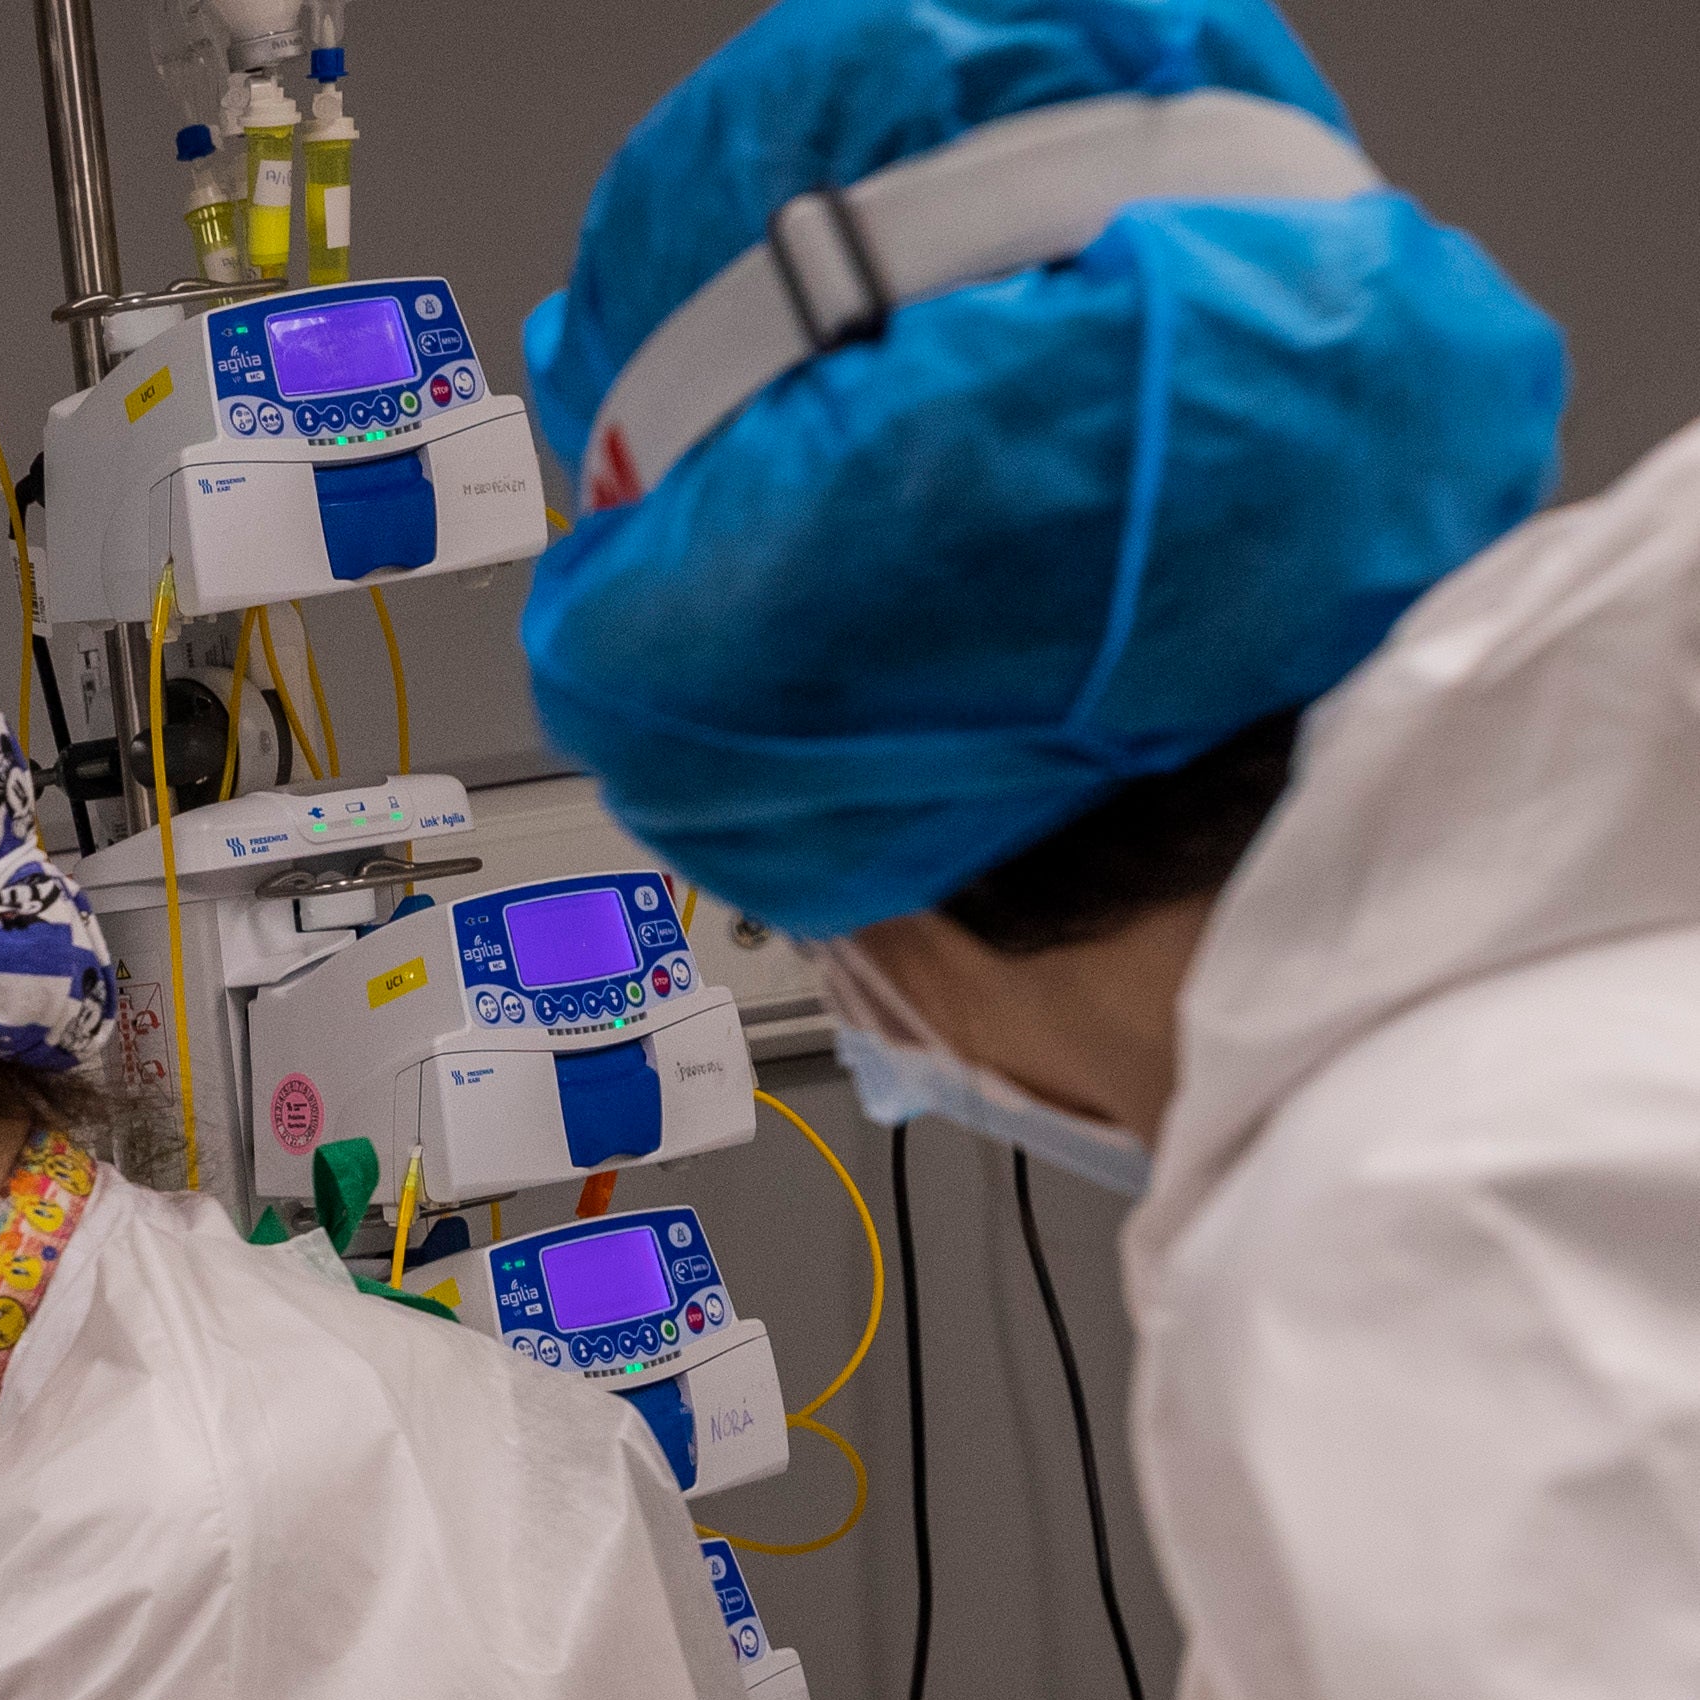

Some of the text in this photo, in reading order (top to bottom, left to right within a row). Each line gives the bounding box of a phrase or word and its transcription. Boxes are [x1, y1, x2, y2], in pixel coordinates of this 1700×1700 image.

[218, 350, 262, 373] agilia
[140, 385, 156, 403] UCI
[432, 386, 449, 396] STOP
[442, 812, 466, 828] Agilia
[250, 834, 289, 847] FRESENIUS
[251, 845, 270, 855] KABI
[463, 941, 503, 962] agilia
[386, 974, 404, 991] UCI
[655, 977, 669, 986] STOP
[500, 1285, 539, 1307] agilia
[687, 1312, 703, 1324] STOP
